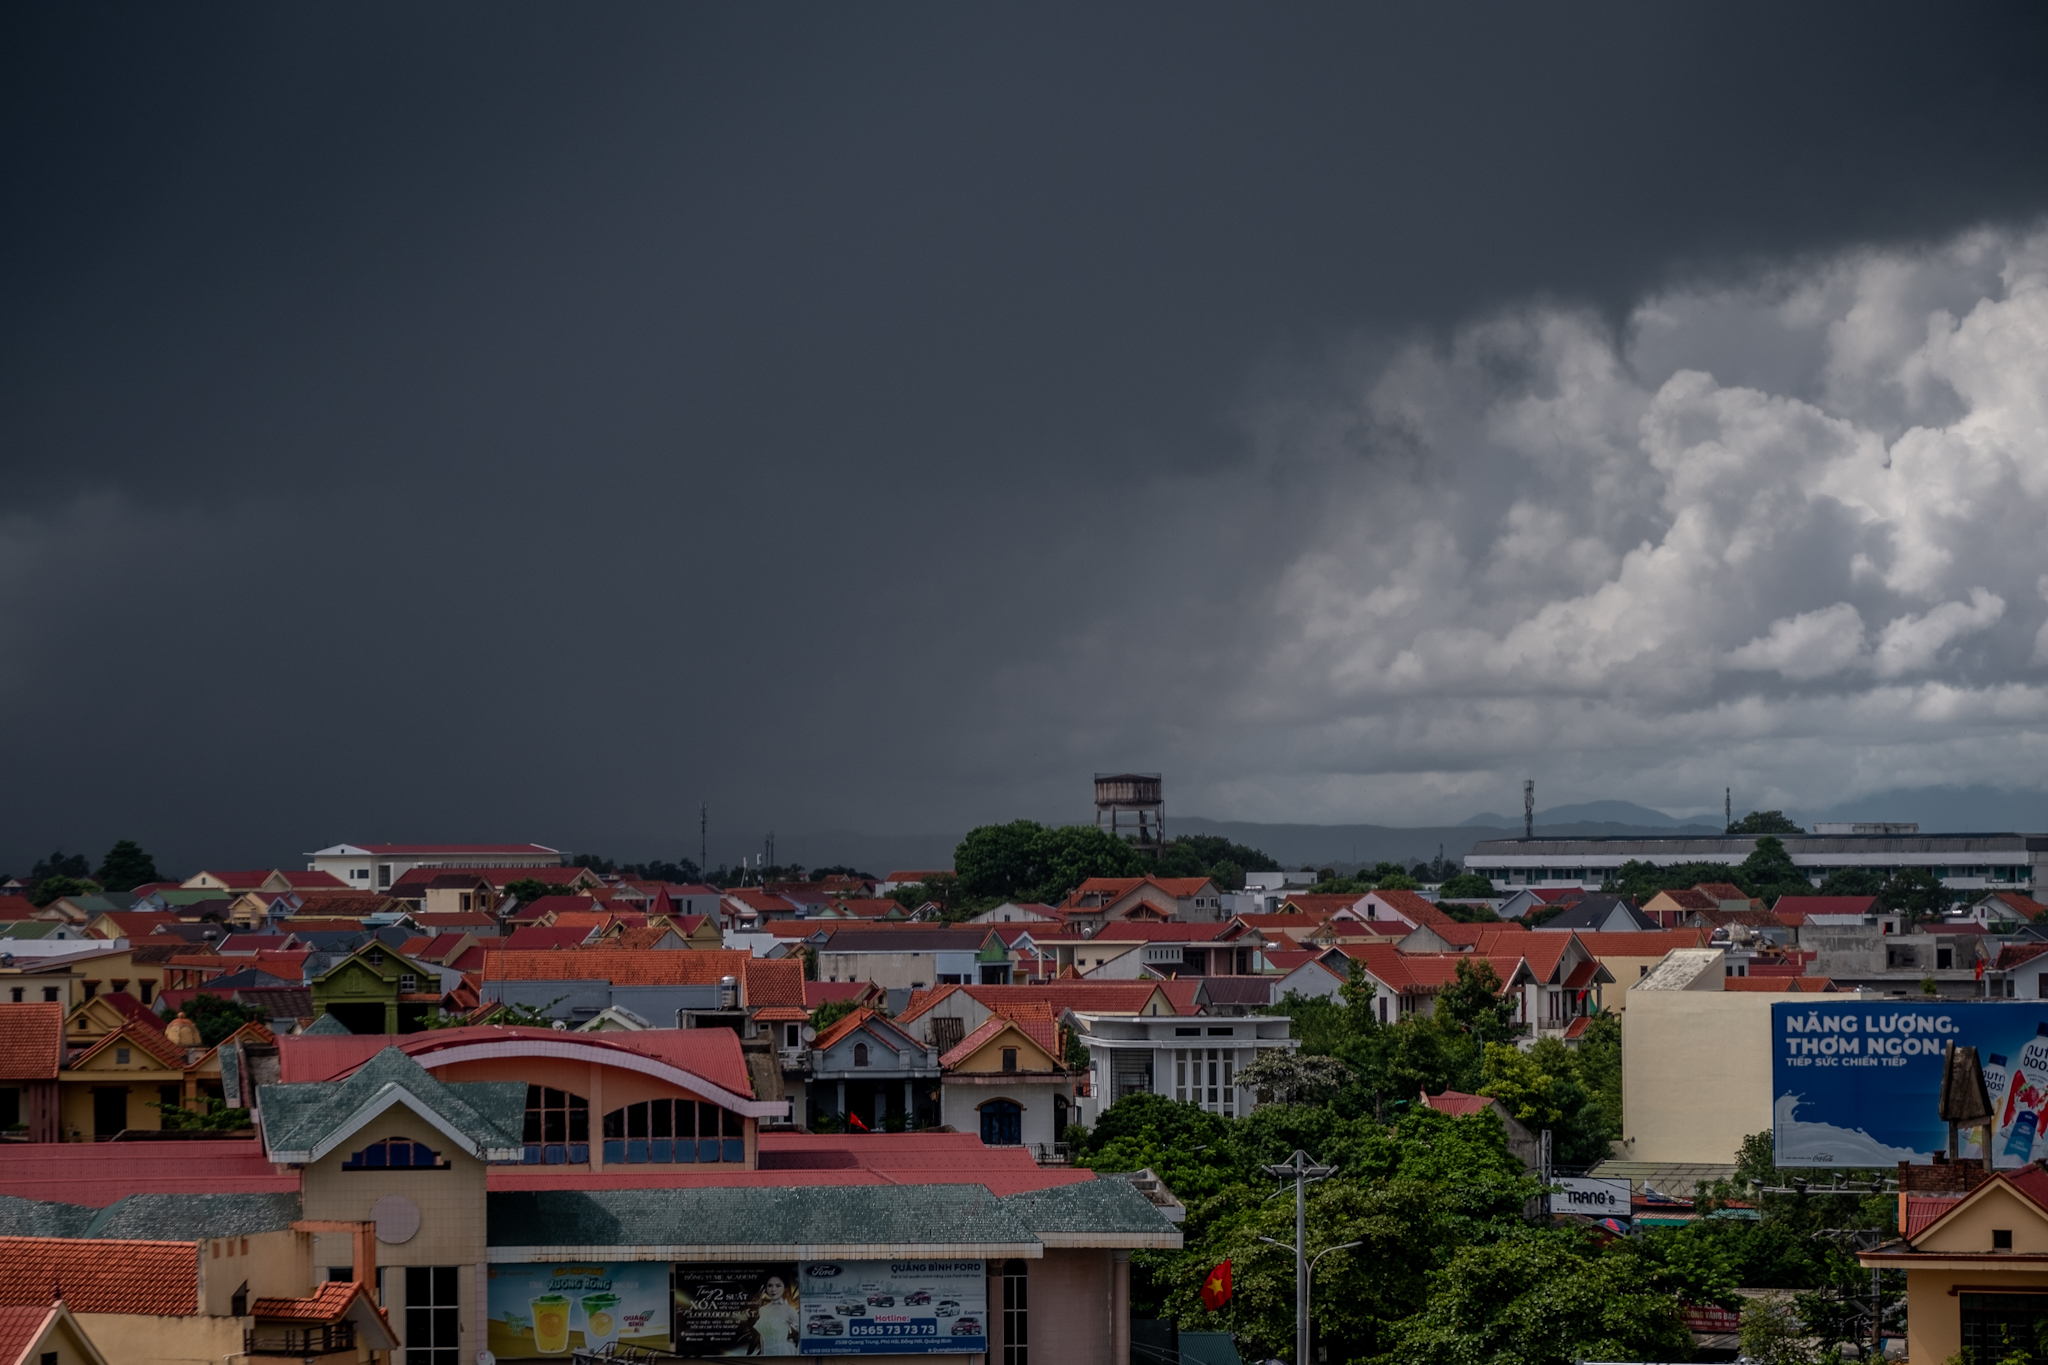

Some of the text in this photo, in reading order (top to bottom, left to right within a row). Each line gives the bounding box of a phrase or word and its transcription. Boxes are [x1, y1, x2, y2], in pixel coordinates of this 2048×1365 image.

[1786, 1011, 1960, 1038] NĂNG LƯỢNG.
[1785, 1034, 1947, 1056] THƠM NGON.
[1786, 1054, 1908, 1067] TIẾP SỨC CHIẾN TIẾP
[812, 1265, 836, 1276] Ford
[891, 1261, 981, 1273] QUẢNG BÌNH FORD
[713, 1288, 724, 1301] 2
[875, 1314, 910, 1323] Hotline:
[852, 1325, 936, 1335] 0565 73 73 73
